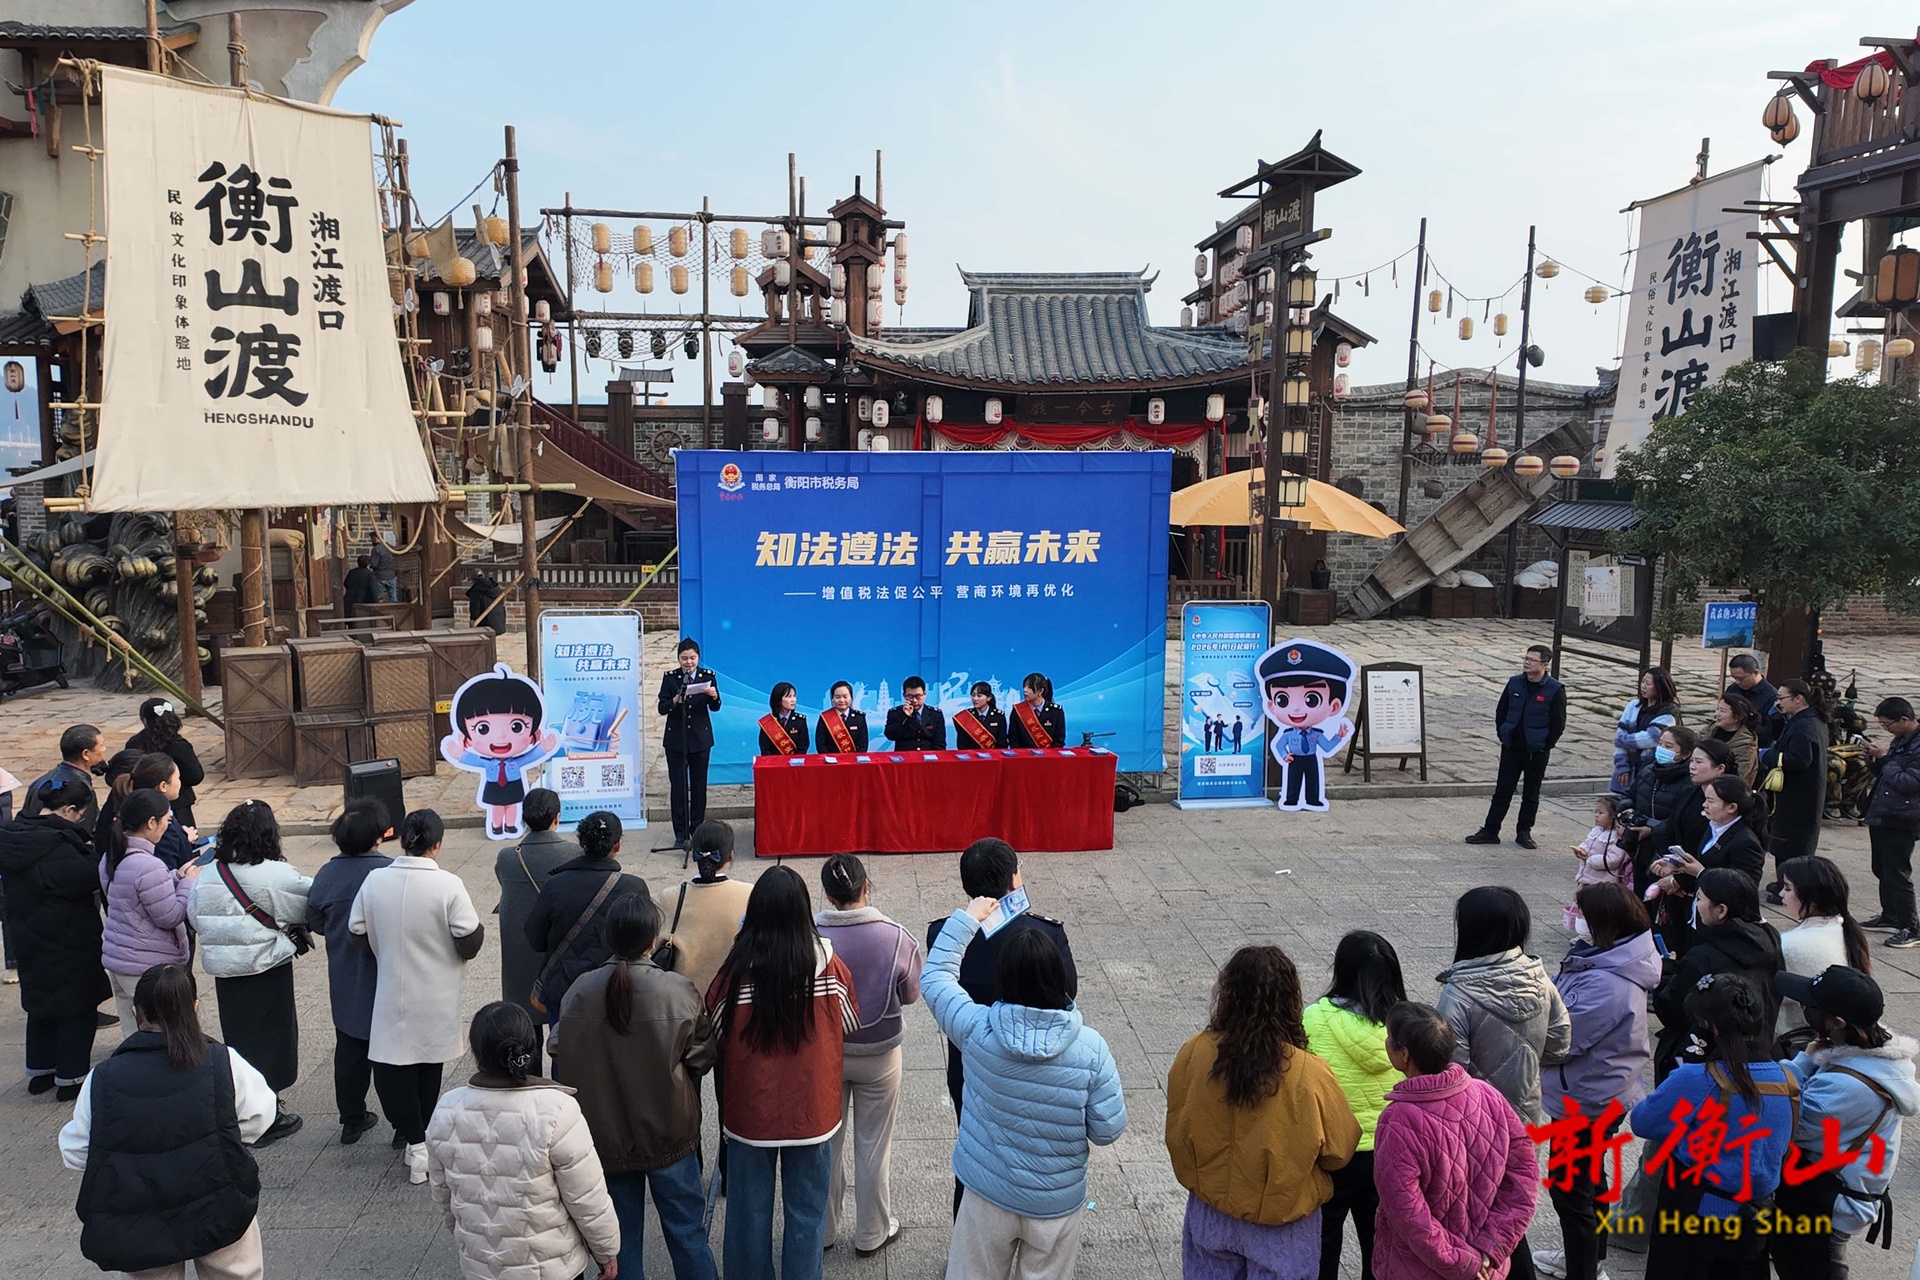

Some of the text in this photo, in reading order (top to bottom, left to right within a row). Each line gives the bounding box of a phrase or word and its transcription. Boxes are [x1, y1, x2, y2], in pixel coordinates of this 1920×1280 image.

[1263, 198, 1301, 233] 衡山渡
[167, 188, 191, 371] 民俗文化印象体验地
[194, 160, 309, 407] 衡山渡
[309, 211, 346, 330] 湘江渡口
[1718, 248, 1742, 353] 湘江渡口
[1652, 229, 1721, 421] 衡山渡
[204, 412, 314, 429] HENGSHANDU
[751, 482, 781, 491] 税务总局
[784, 475, 860, 490] 衡阳市税务局
[755, 530, 1102, 567] 知法遵法 共赢未来
[956, 583, 1076, 599] 营商环境再优化
[555, 644, 613, 658] 知法遵法
[576, 658, 631, 672] 共赢未来
